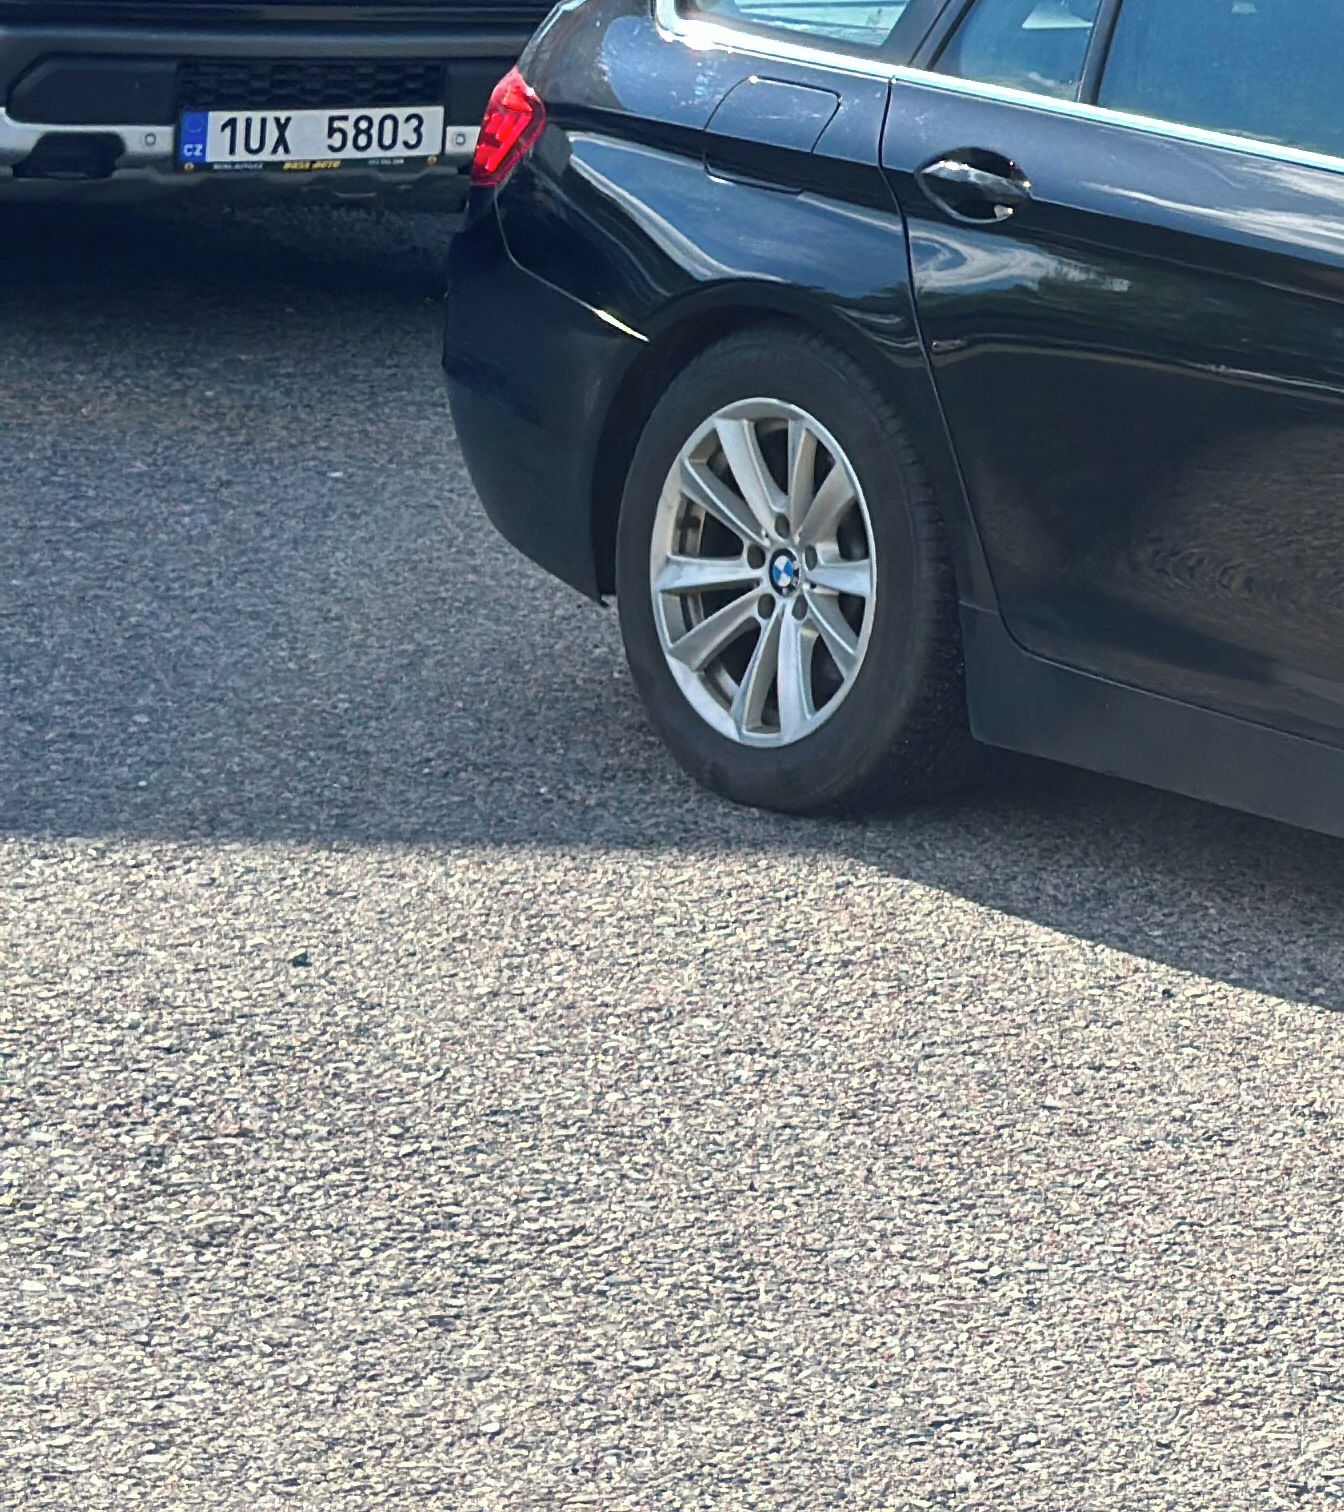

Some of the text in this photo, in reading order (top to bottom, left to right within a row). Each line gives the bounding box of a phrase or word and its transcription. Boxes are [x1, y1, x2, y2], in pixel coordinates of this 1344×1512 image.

[184, 113, 424, 156] CZ 1UX 5803
